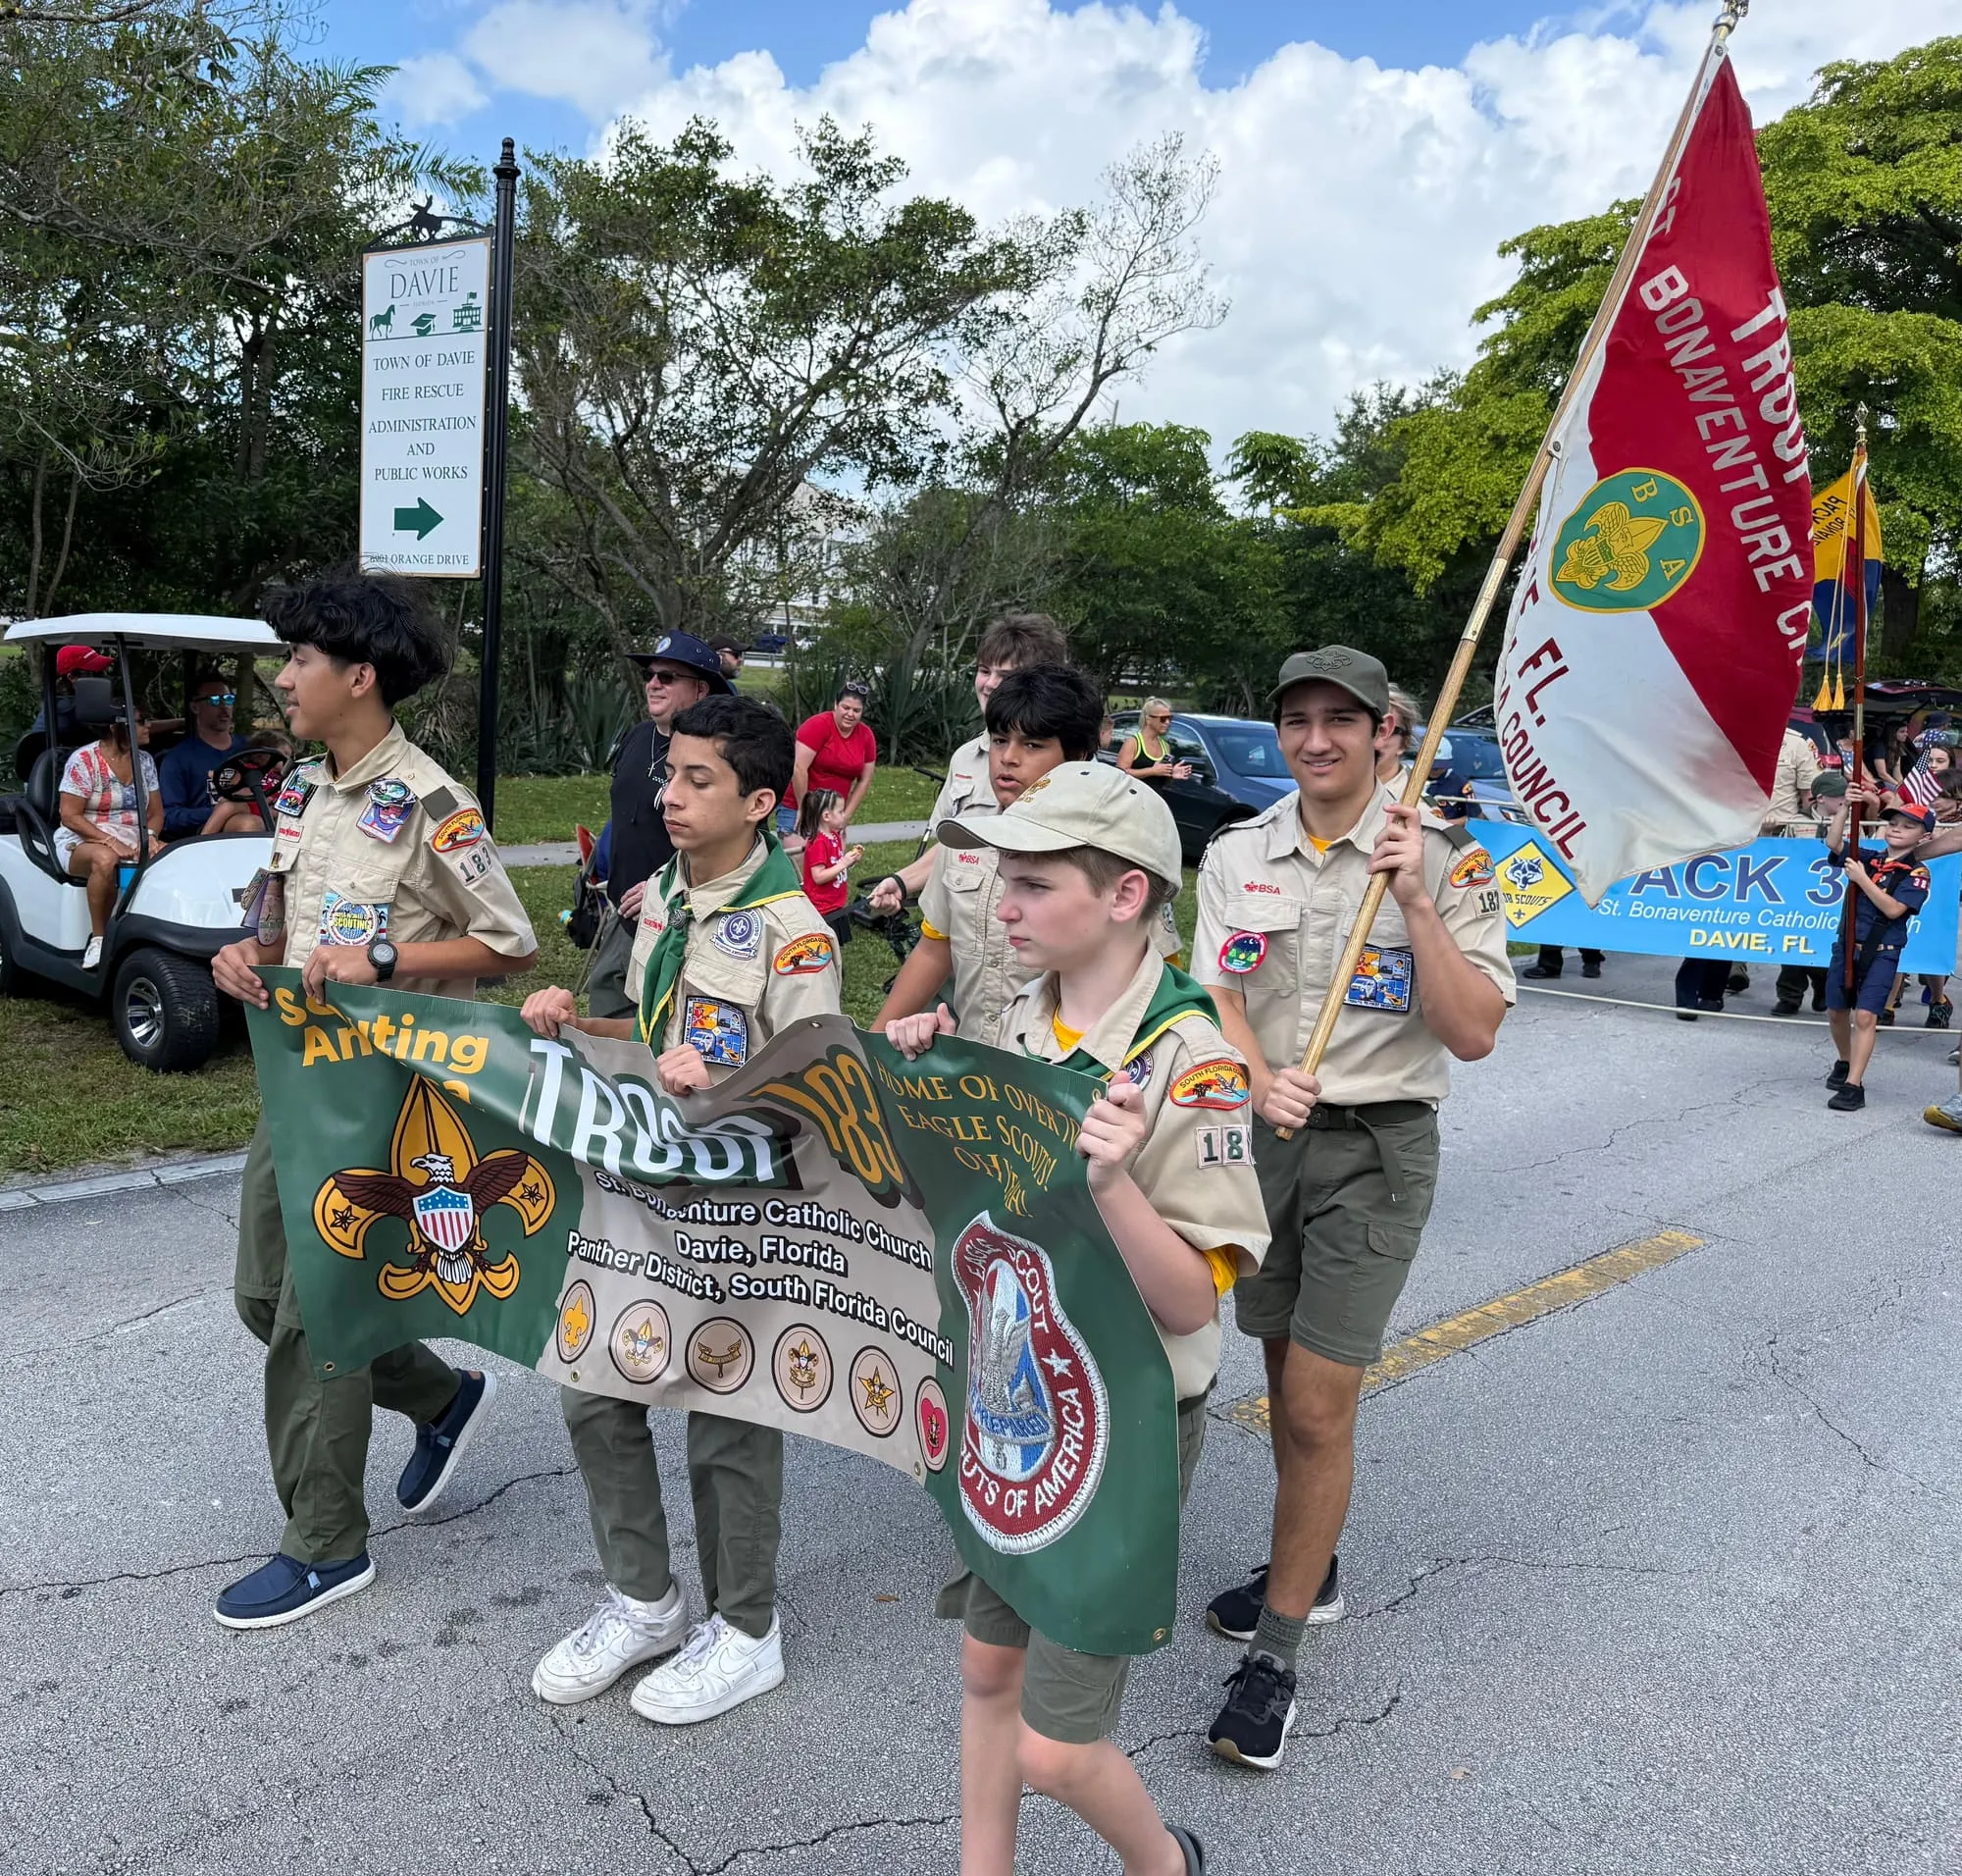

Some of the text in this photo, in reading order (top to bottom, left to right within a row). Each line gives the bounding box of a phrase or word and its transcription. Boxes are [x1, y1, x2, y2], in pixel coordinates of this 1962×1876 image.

[430, 255, 439, 264] OF
[390, 266, 459, 299] DAVIE
[374, 350, 476, 371] TOWN OF DAVIE
[382, 384, 464, 401] FIRE RESCUE
[368, 415, 477, 434] ADMINISTRATION
[1639, 264, 1805, 593] BONAVENTURE
[406, 443, 436, 456] AND
[375, 466, 468, 481] PUBLIC WORKS
[391, 553, 434, 565] ORANGE
[437, 553, 469, 565] DRIVE
[1518, 637, 1570, 727] FL.
[1501, 711, 1587, 860] COUNCIL
[1259, 883, 1281, 895] BSA
[1628, 854, 1789, 904] ACK
[1515, 893, 1553, 907] SCOUTS
[1598, 898, 1838, 930] St. Bonaventure Catholic
[1689, 928, 1817, 956] DAVIE, FL
[1179, 1071, 1205, 1089] SOUTH
[1206, 1065, 1233, 1076] FLORIDA
[873, 1057, 953, 1101] HOME
[1004, 1083, 1060, 1136] OVER
[896, 1103, 1058, 1192] EAGLE SCOUTS!
[1203, 1130, 1244, 1162] 18
[953, 1146, 1004, 1184] OH
[765, 1198, 862, 1238] Catholic
[864, 1221, 933, 1269] Church
[675, 1230, 846, 1273] Davie, Florida
[567, 1231, 955, 1368] Panther District, South Florida Council
[1003, 1241, 1051, 1334] SCOUT
[1004, 1488, 1029, 1518] OF
[1034, 1387, 1086, 1515] AMERICA
